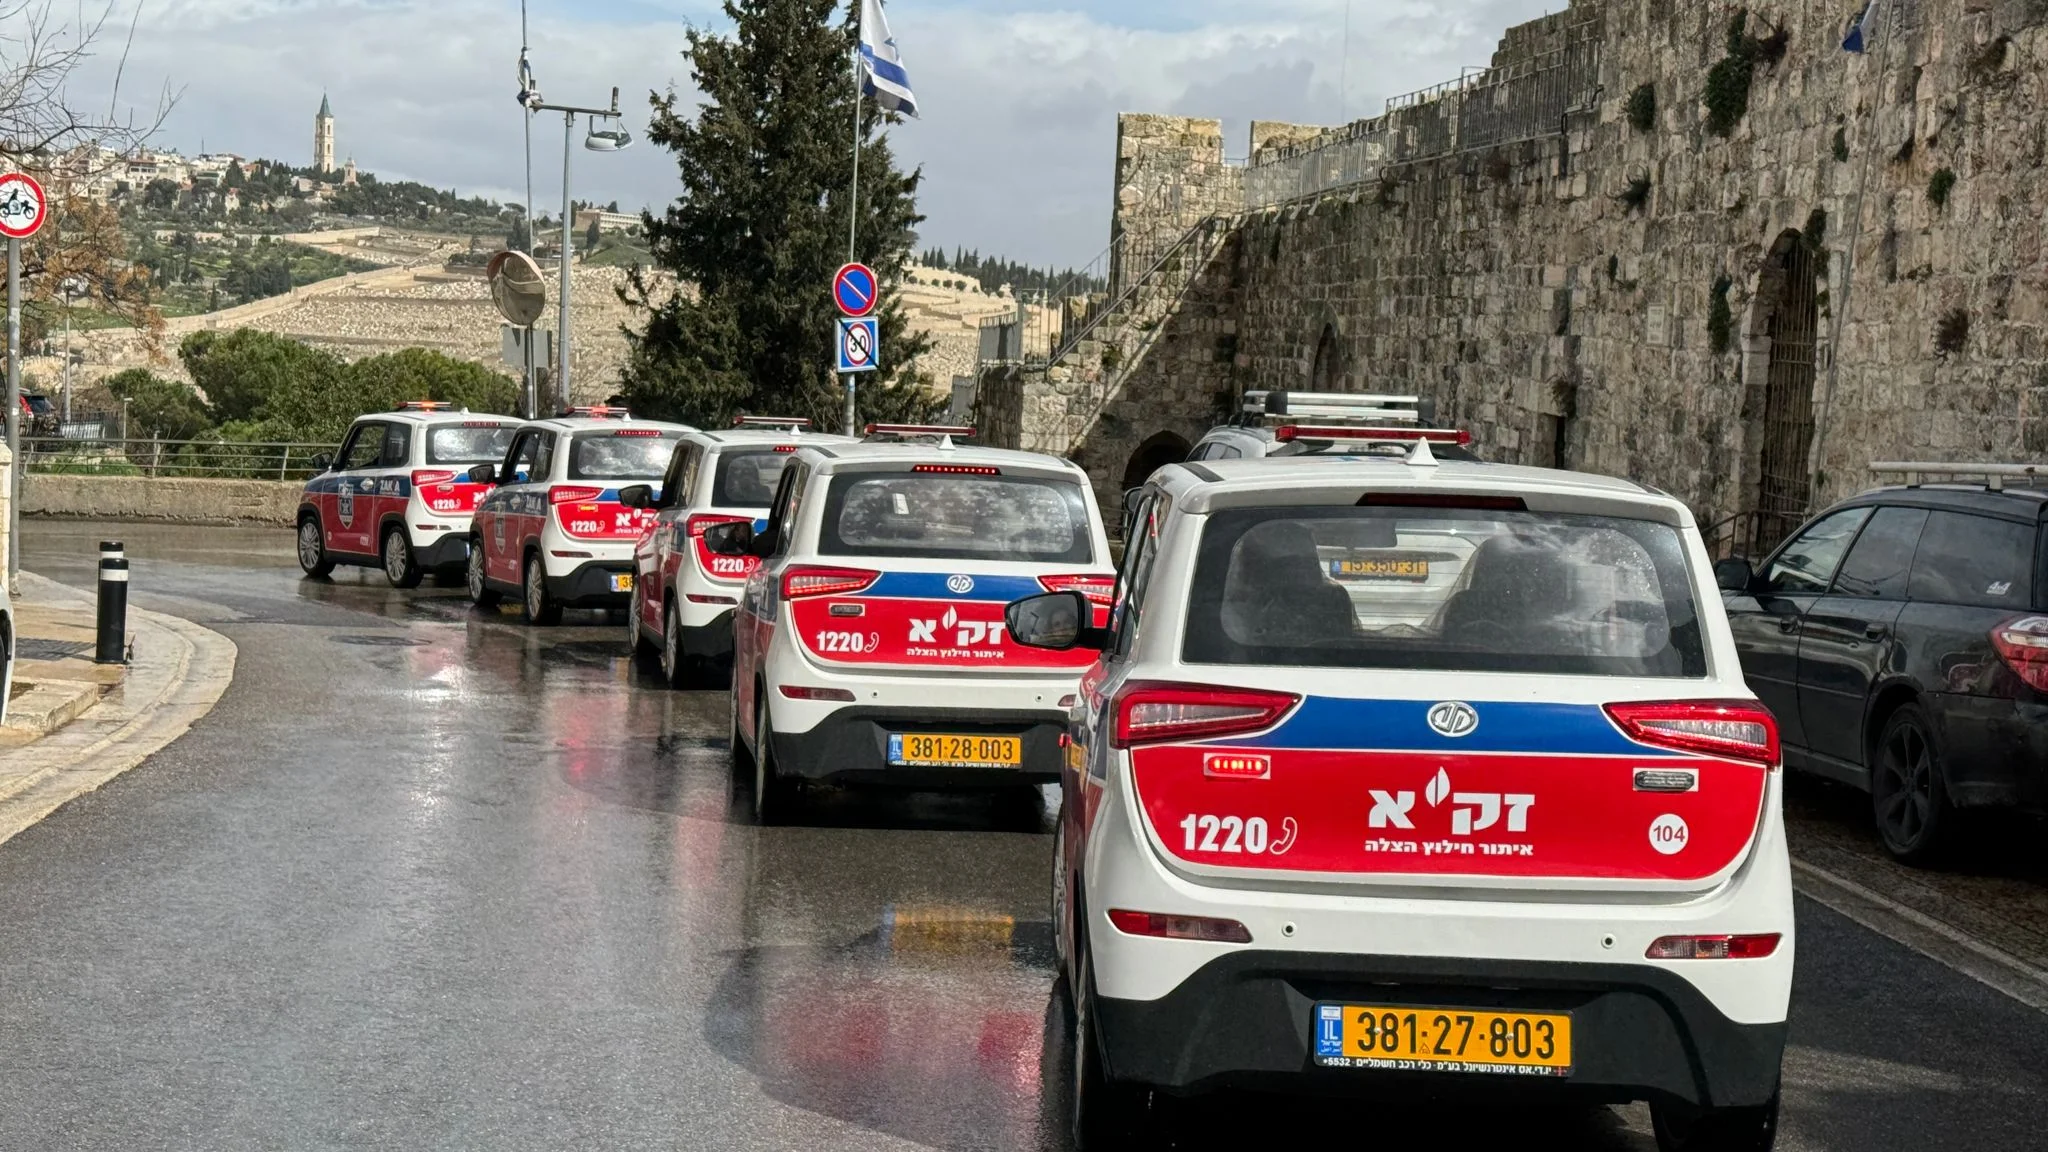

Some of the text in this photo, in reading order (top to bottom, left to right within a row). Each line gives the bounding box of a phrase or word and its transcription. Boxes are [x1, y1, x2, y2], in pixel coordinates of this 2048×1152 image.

[850, 335, 867, 353] 30
[432, 499, 455, 510] 1220
[570, 520, 597, 533] 1220
[711, 557, 745, 573] 1220
[816, 631, 864, 653] 1220
[906, 646, 1005, 659] איתור חילוץ הצלה
[1180, 813, 1268, 854] 1220
[1653, 825, 1686, 843] 104
[1364, 837, 1534, 857] איתור חילוץ הצלה
[1324, 1020, 1338, 1040] IL
[1356, 1057, 1397, 1068] חשמליים
[1398, 1060, 1416, 1069] רכב
[1417, 1059, 1432, 1070] כלי
